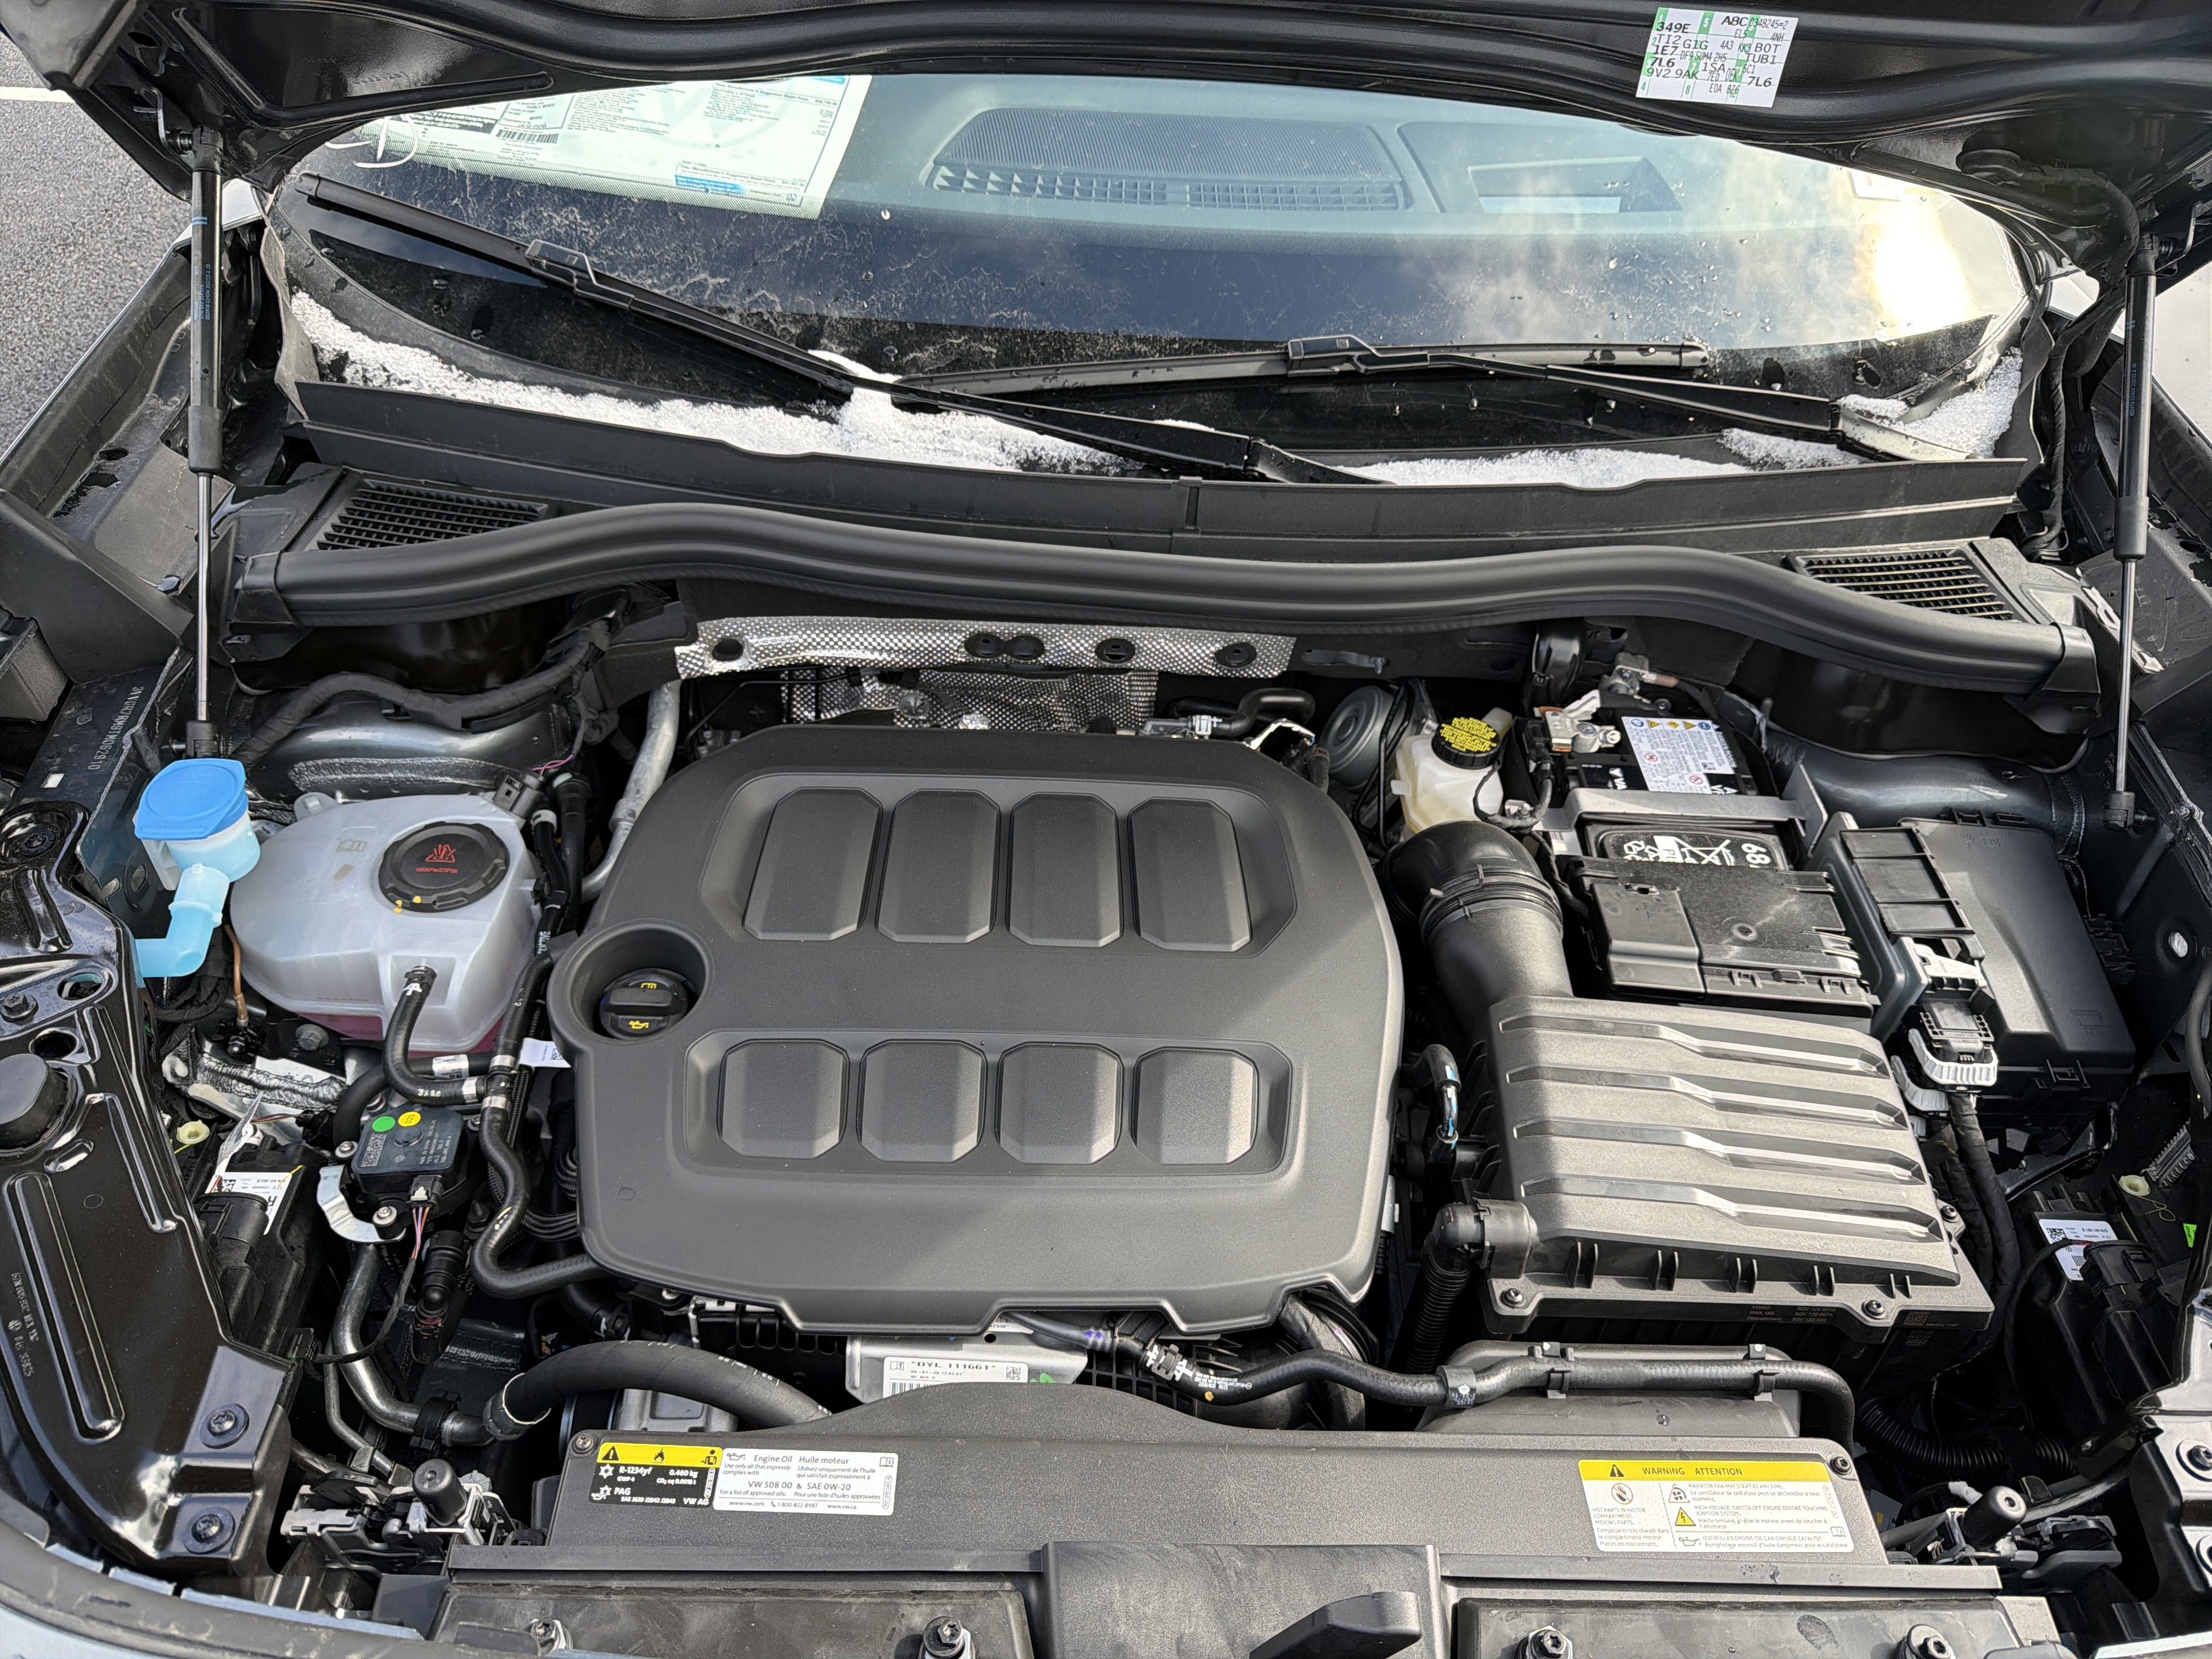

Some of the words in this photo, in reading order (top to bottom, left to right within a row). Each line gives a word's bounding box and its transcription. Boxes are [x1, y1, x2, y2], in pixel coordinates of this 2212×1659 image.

[1656, 22, 1691, 33] 349E
[1703, 18, 1709, 27] 5
[1650, 57, 1676, 67] 7L6
[1747, 76, 1773, 88] 7L6
[1685, 84, 1691, 95] 8
[753, 1454, 780, 1464] Engine
[799, 1455, 819, 1464] Huile
[619, 1466, 653, 1476] R-1234yf
[690, 1469, 698, 1479] kg
[1641, 1467, 1685, 1476] WARNING
[1695, 1468, 1743, 1476] ATTENTION
[764, 1481, 779, 1489] 508
[614, 1487, 631, 1496] PAG
[683, 1497, 697, 1505] VW
[697, 1498, 709, 1506] AG
